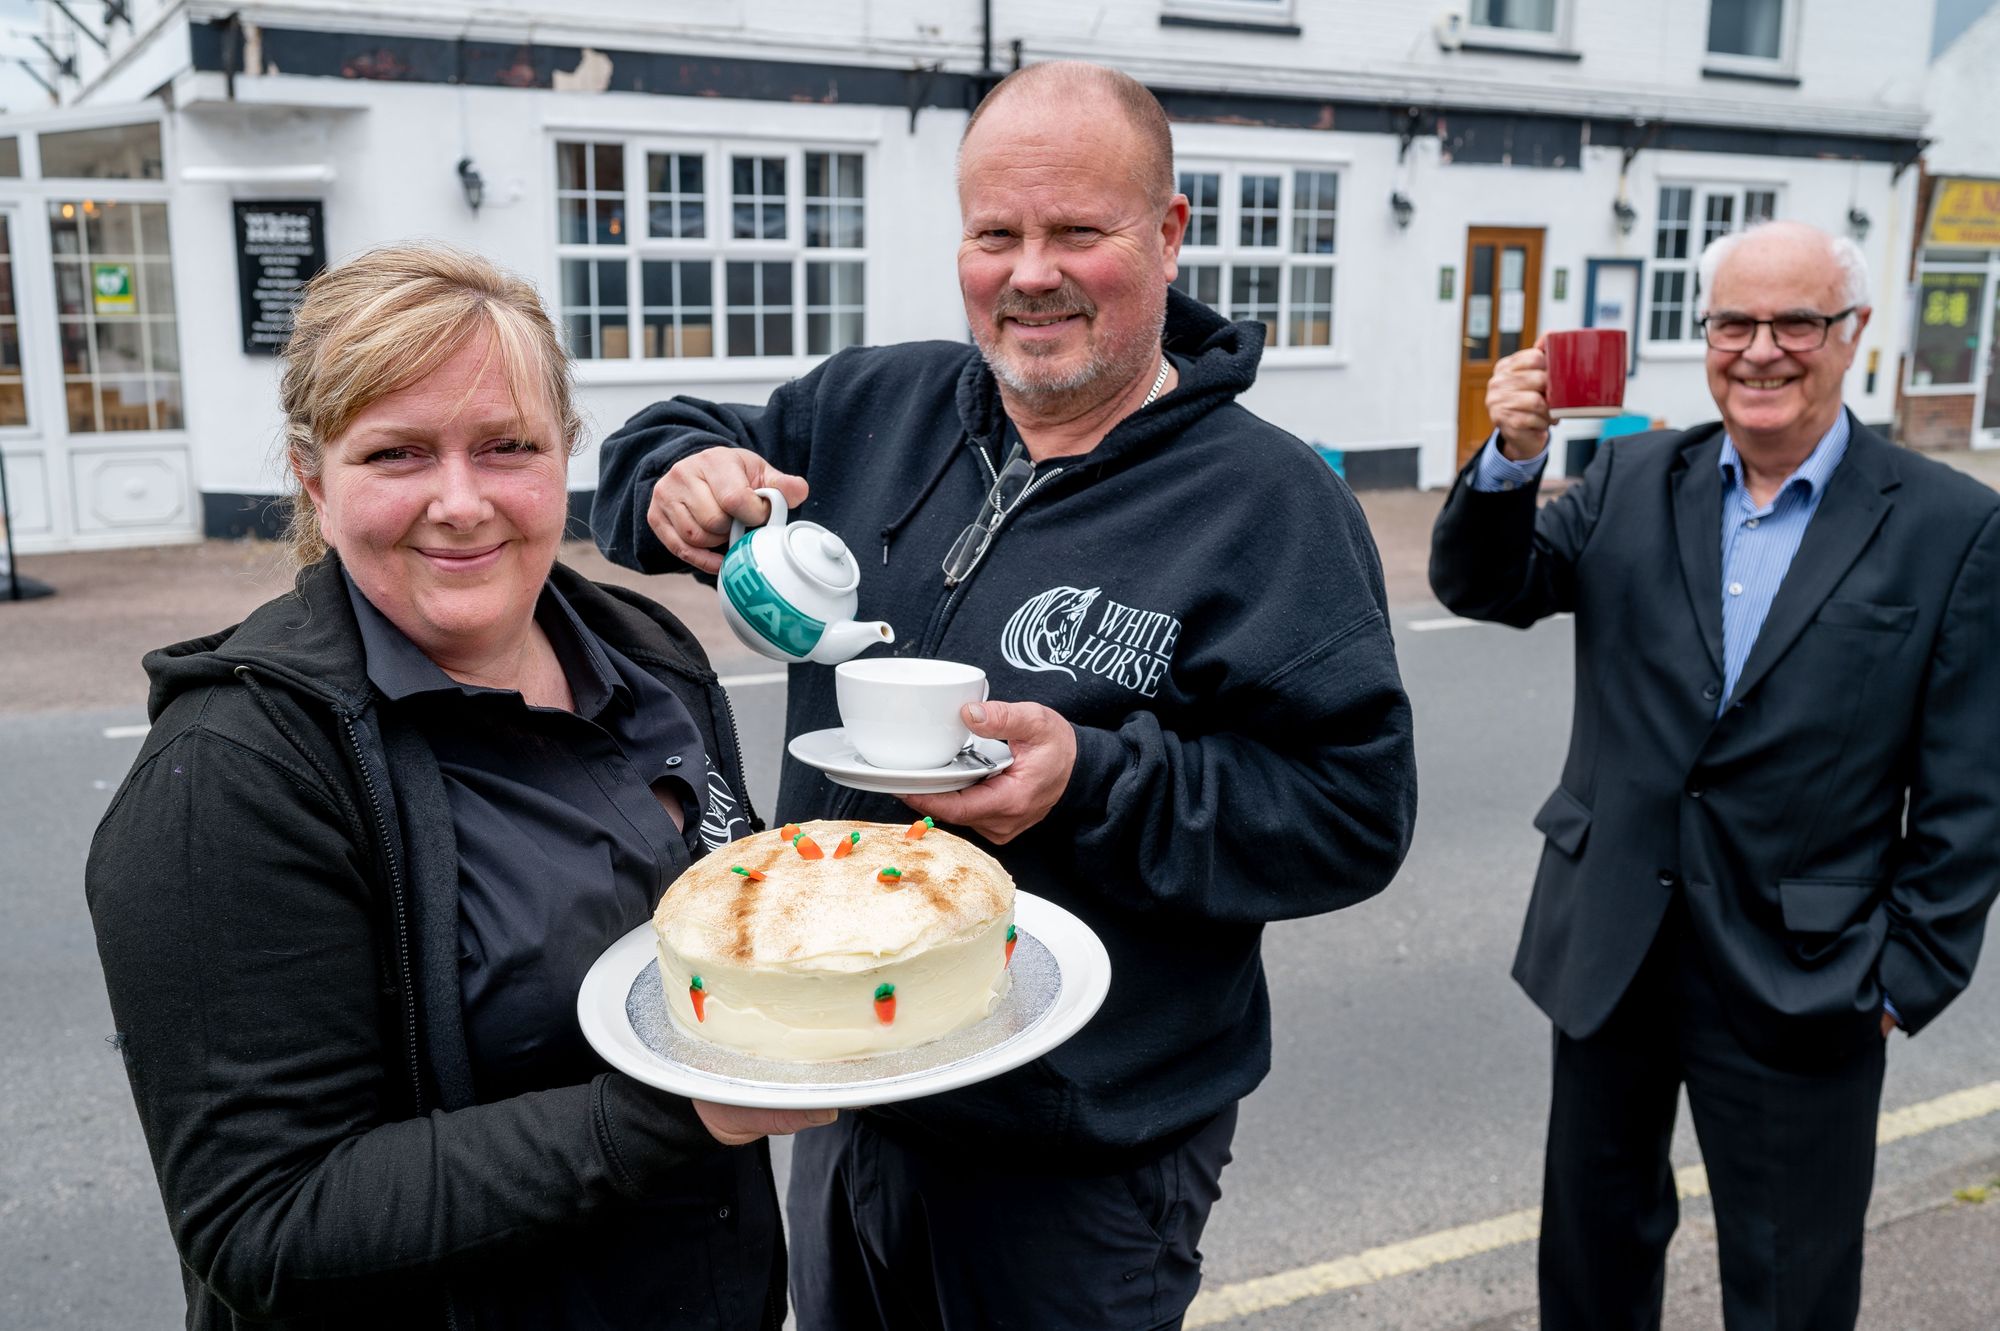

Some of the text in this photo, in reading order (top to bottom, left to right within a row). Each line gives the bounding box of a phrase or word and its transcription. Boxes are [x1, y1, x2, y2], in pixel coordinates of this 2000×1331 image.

[723, 540, 781, 638] TEA
[1097, 600, 1182, 660] WHITE
[1069, 634, 1168, 698] HORSE
